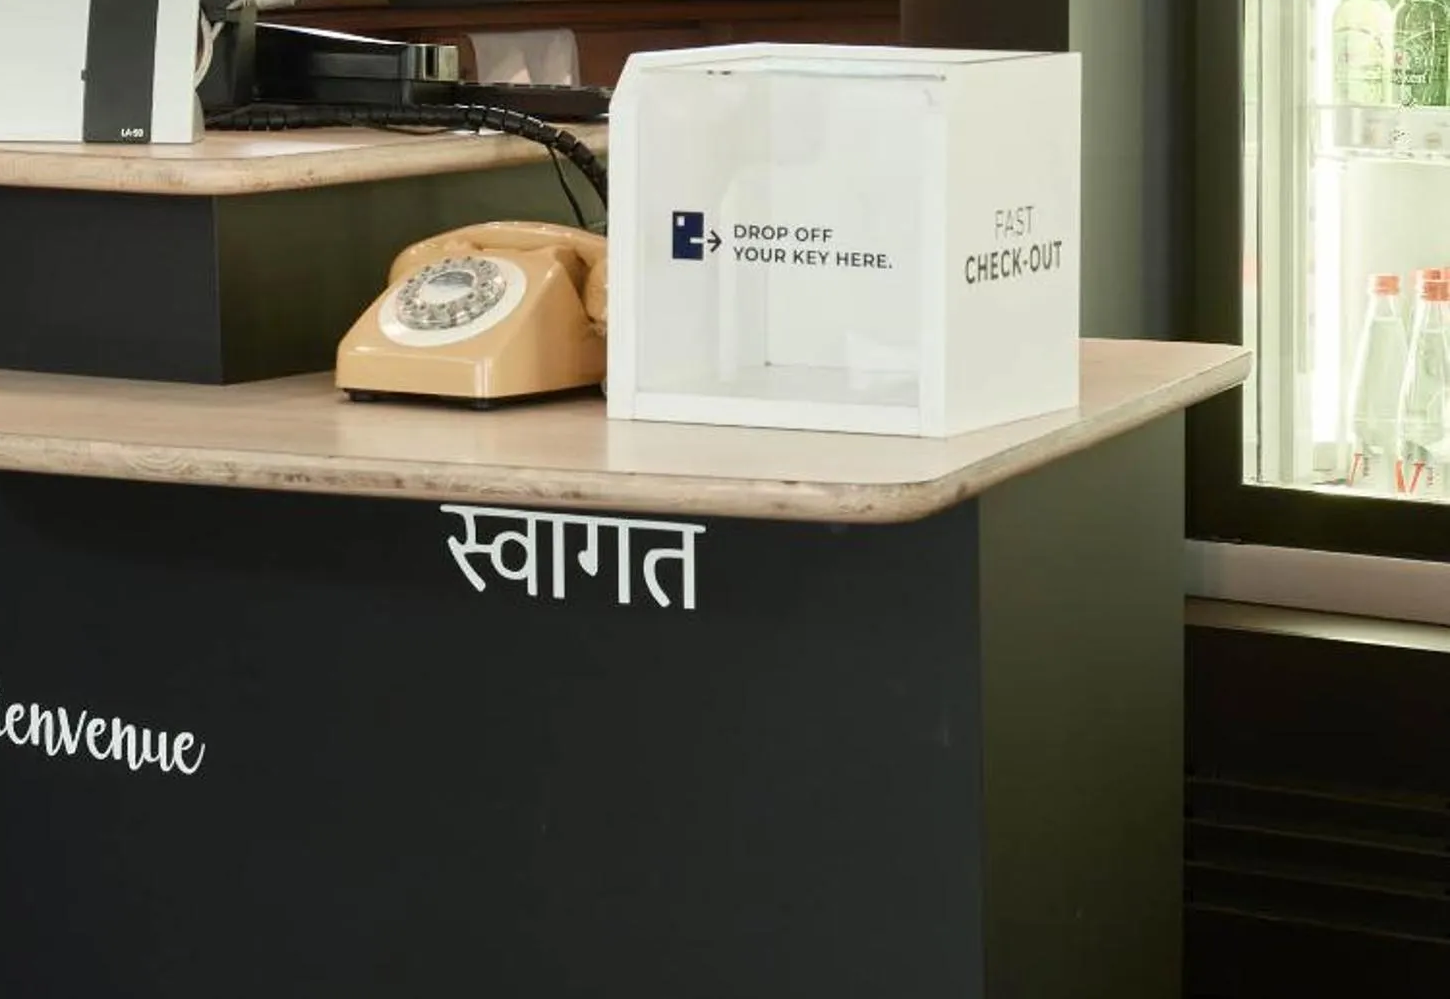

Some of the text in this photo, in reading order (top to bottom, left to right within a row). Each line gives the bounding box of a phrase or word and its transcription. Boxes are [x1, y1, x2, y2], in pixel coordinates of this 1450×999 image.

[733, 224, 834, 243] DROP OFF
[995, 205, 1035, 240] FAST
[732, 246, 894, 269] YOUR KEY HERE.
[965, 240, 1063, 284] CHECK-OUT
[440, 503, 707, 611] स्वागत
